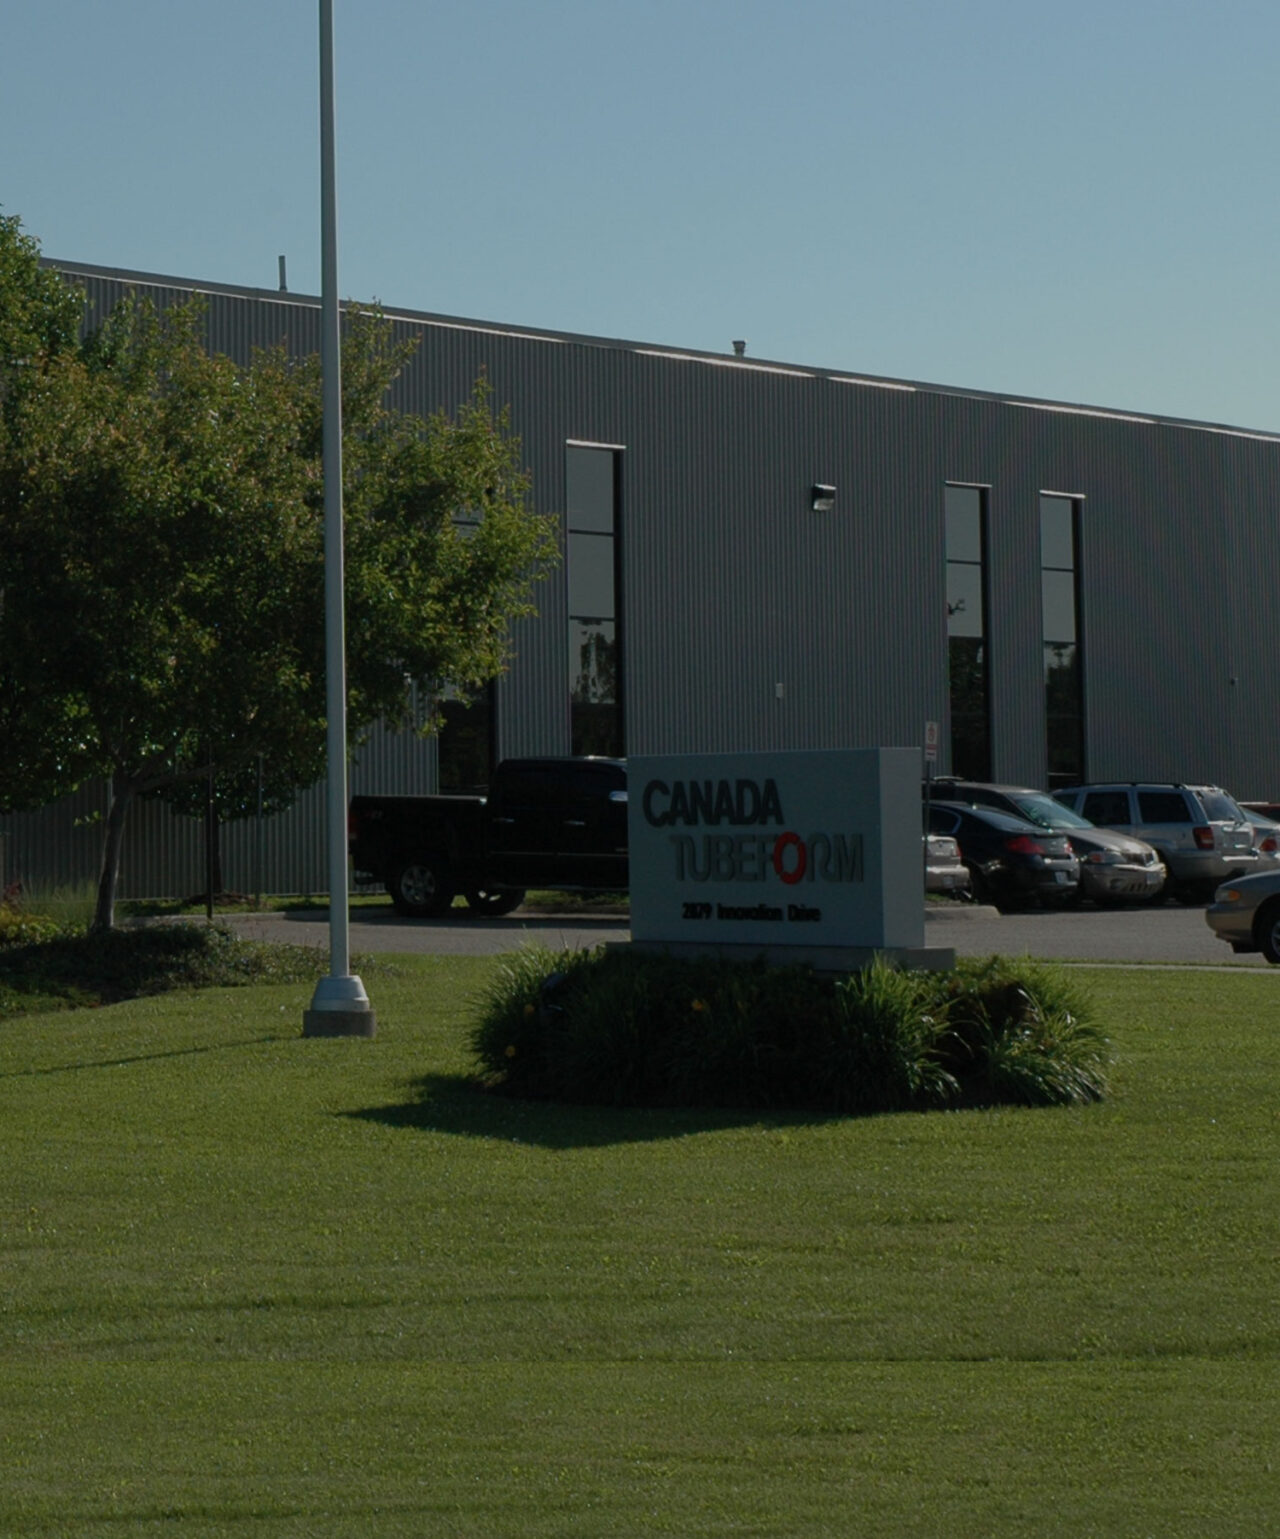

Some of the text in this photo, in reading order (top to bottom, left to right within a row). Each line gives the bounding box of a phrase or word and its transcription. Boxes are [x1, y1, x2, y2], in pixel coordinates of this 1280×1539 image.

[644, 778, 784, 827] CANADA
[670, 831, 864, 885] TUBEFORM
[717, 903, 783, 921] Innovation
[788, 904, 821, 921] Drive
